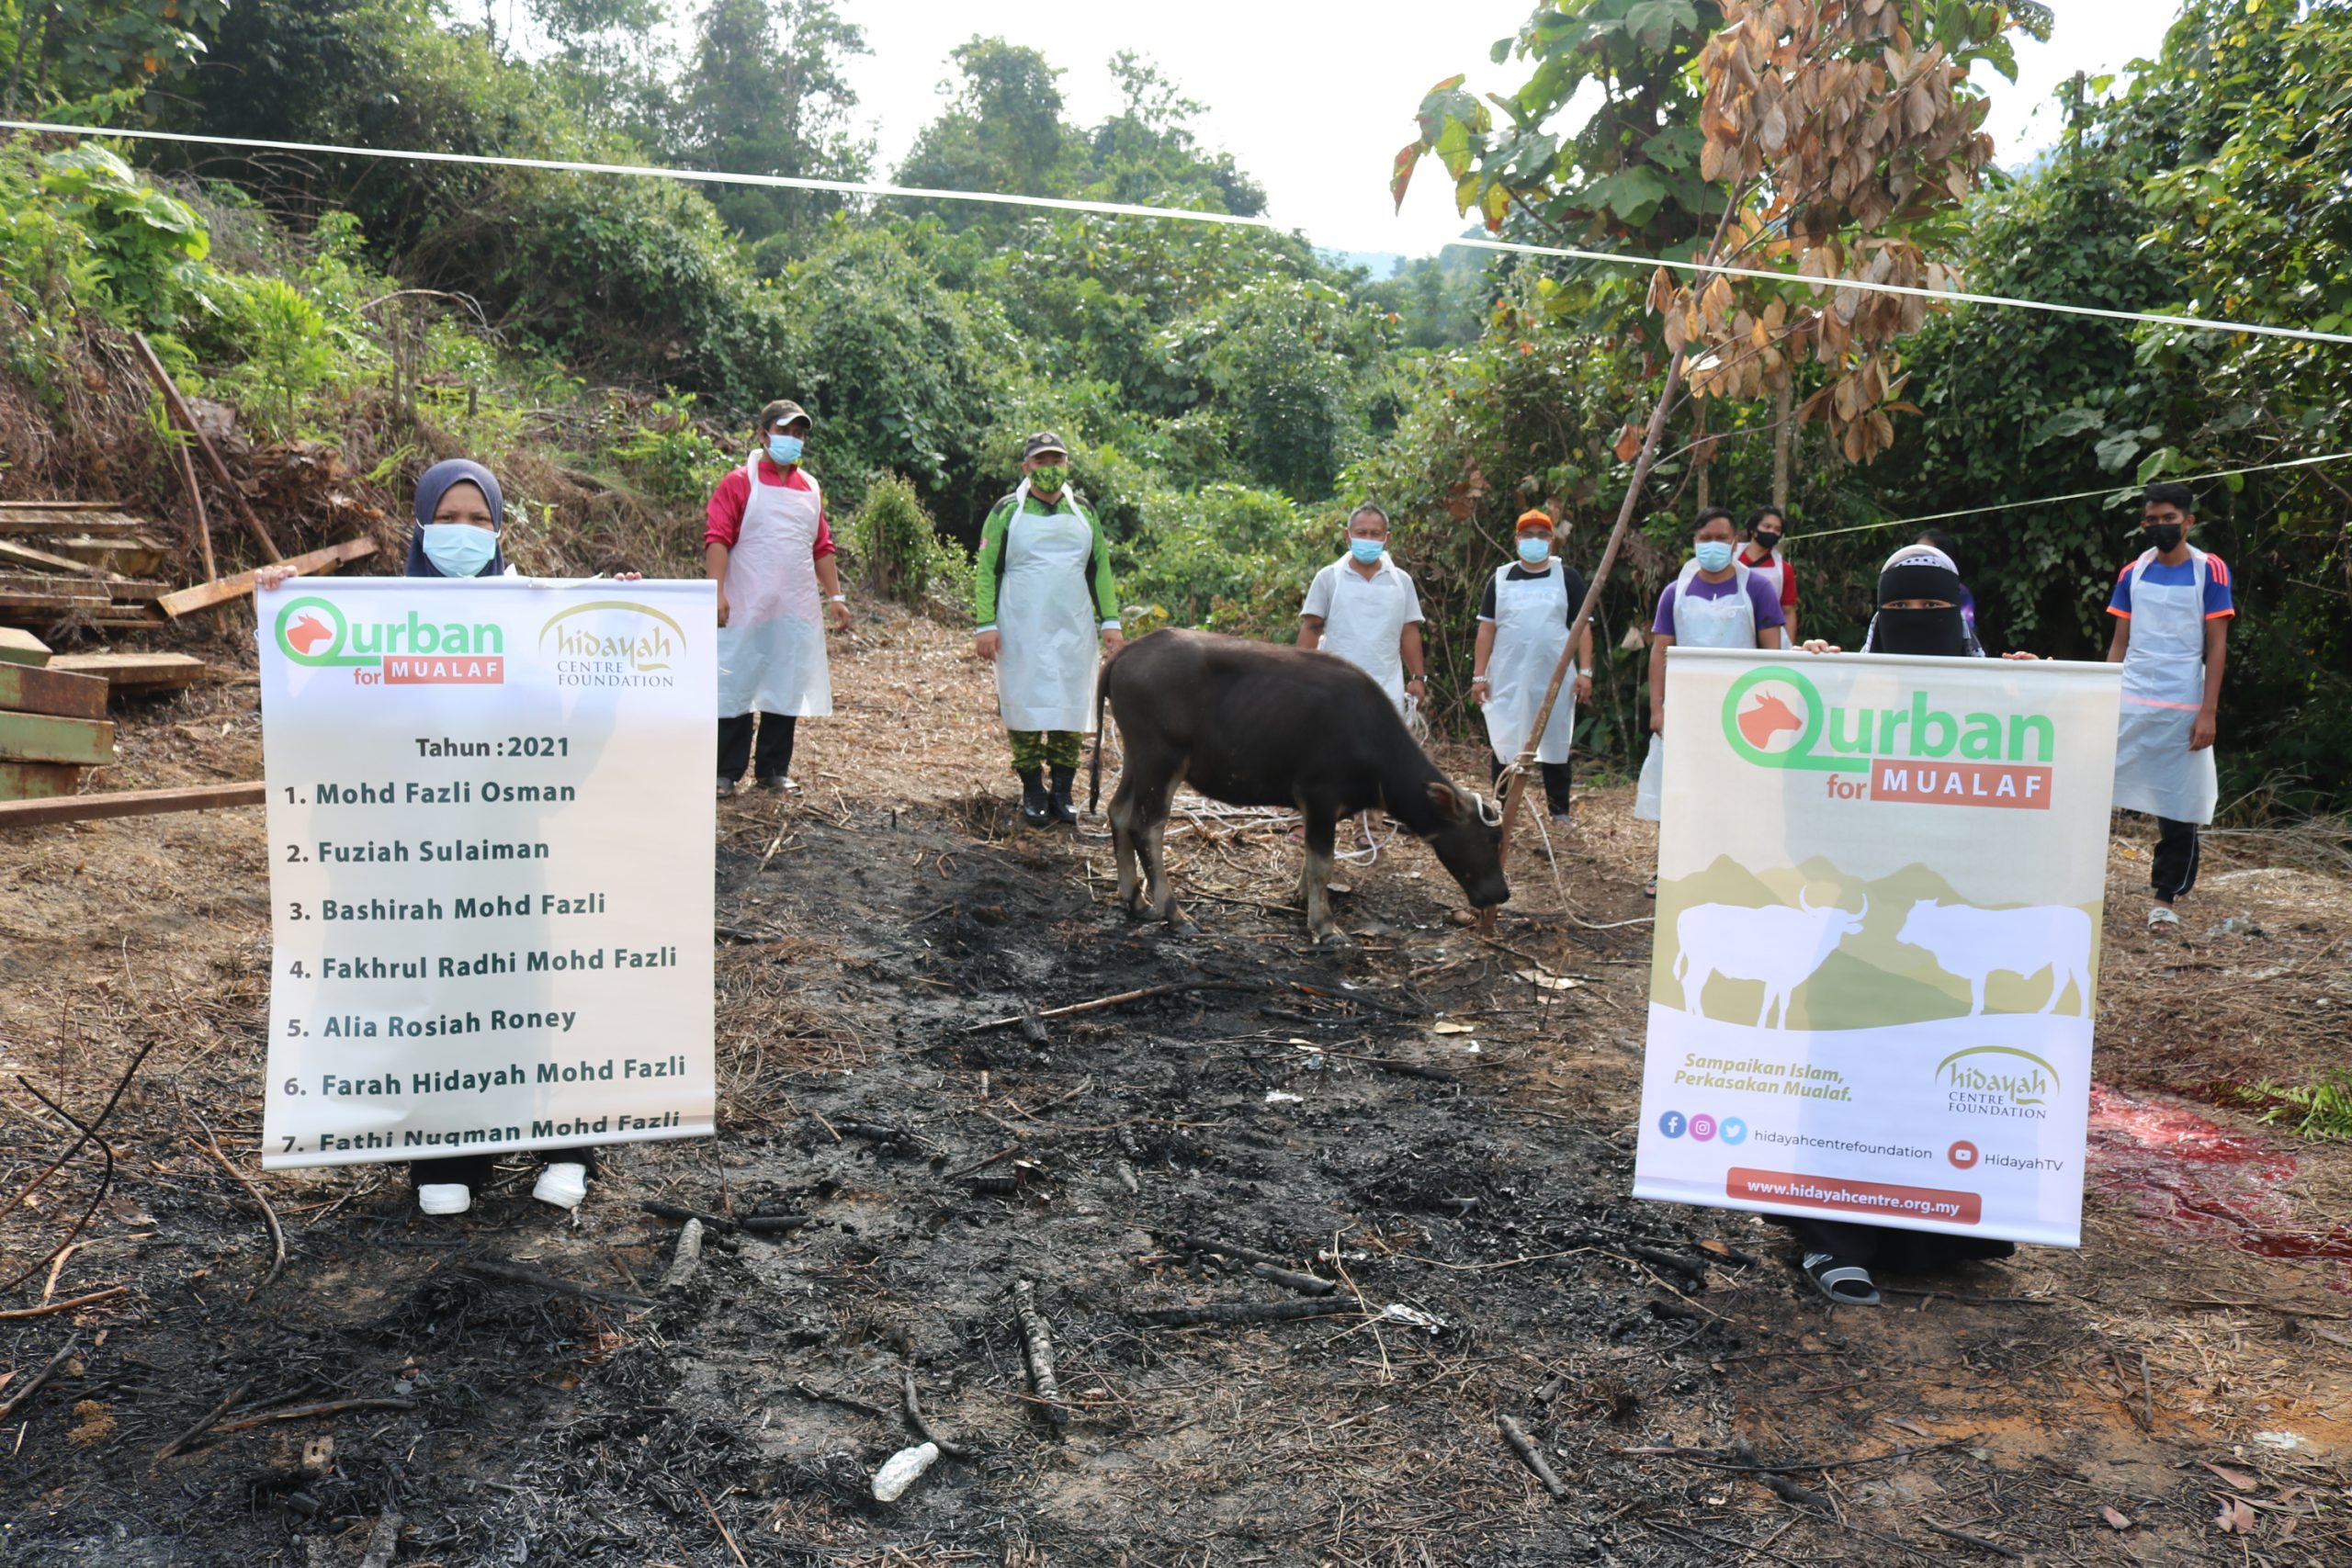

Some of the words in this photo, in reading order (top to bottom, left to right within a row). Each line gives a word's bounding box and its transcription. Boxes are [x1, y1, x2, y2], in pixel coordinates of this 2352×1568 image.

[276, 596, 503, 666] Qurban
[557, 624, 673, 671] hidayah
[354, 668, 380, 685] for
[391, 661, 498, 678] MUALAF
[557, 660, 623, 673] CENTRE
[559, 674, 673, 687] FOUNDATION
[1722, 665, 2055, 773] Qurban
[416, 739, 491, 758] Tahun
[507, 737, 569, 757] 2021
[285, 787, 306, 805] 1.
[317, 784, 395, 805] Mohd
[406, 782, 471, 804] Fazli
[481, 782, 575, 803] Osman
[1826, 774, 1867, 799] for
[1882, 769, 2041, 798] MUALAF
[287, 845, 309, 863] 2.
[318, 840, 410, 863] Fuziah
[420, 840, 549, 862] Sulaiman
[290, 903, 311, 920] 3.
[322, 898, 442, 920] Bashirah
[454, 895, 530, 919] Mohd
[541, 893, 605, 916] Fazli
[289, 961, 311, 978] 4.
[323, 957, 427, 978] Fakhrul
[438, 953, 515, 977] Radhi
[526, 949, 604, 971] Mohd
[615, 947, 677, 968] Fazli
[288, 1019, 309, 1037] 5.
[323, 1015, 378, 1037] Alia
[389, 1012, 481, 1037] Rosiah
[491, 1010, 576, 1032] Roney
[284, 1077, 306, 1096] 6.
[322, 1073, 401, 1096] Farah
[413, 1065, 526, 1094] Hidayah
[537, 1059, 614, 1084] Mohd
[624, 1056, 685, 1078] Fazli
[1684, 1053, 1786, 1077] Sampaikan
[1789, 1063, 1845, 1084] Islam,
[1674, 1069, 1779, 1094] Perkasakan
[1782, 1080, 1852, 1102] Mualaf.
[1949, 1091, 2005, 1105] CENTRE
[1951, 1062, 2046, 1107] hidayah
[1949, 1102, 2047, 1120] FOUNDATION
[282, 1135, 304, 1154] 7.
[320, 1131, 393, 1151] Fathi
[531, 1116, 608, 1139] Mohd
[617, 1111, 680, 1132] Fazli
[1754, 1129, 1933, 1159] hidayahcentrefoundation
[1984, 1154, 2064, 1172] HidayahTV
[1747, 1179, 1961, 1217] www.hidayahcentre.org.my
